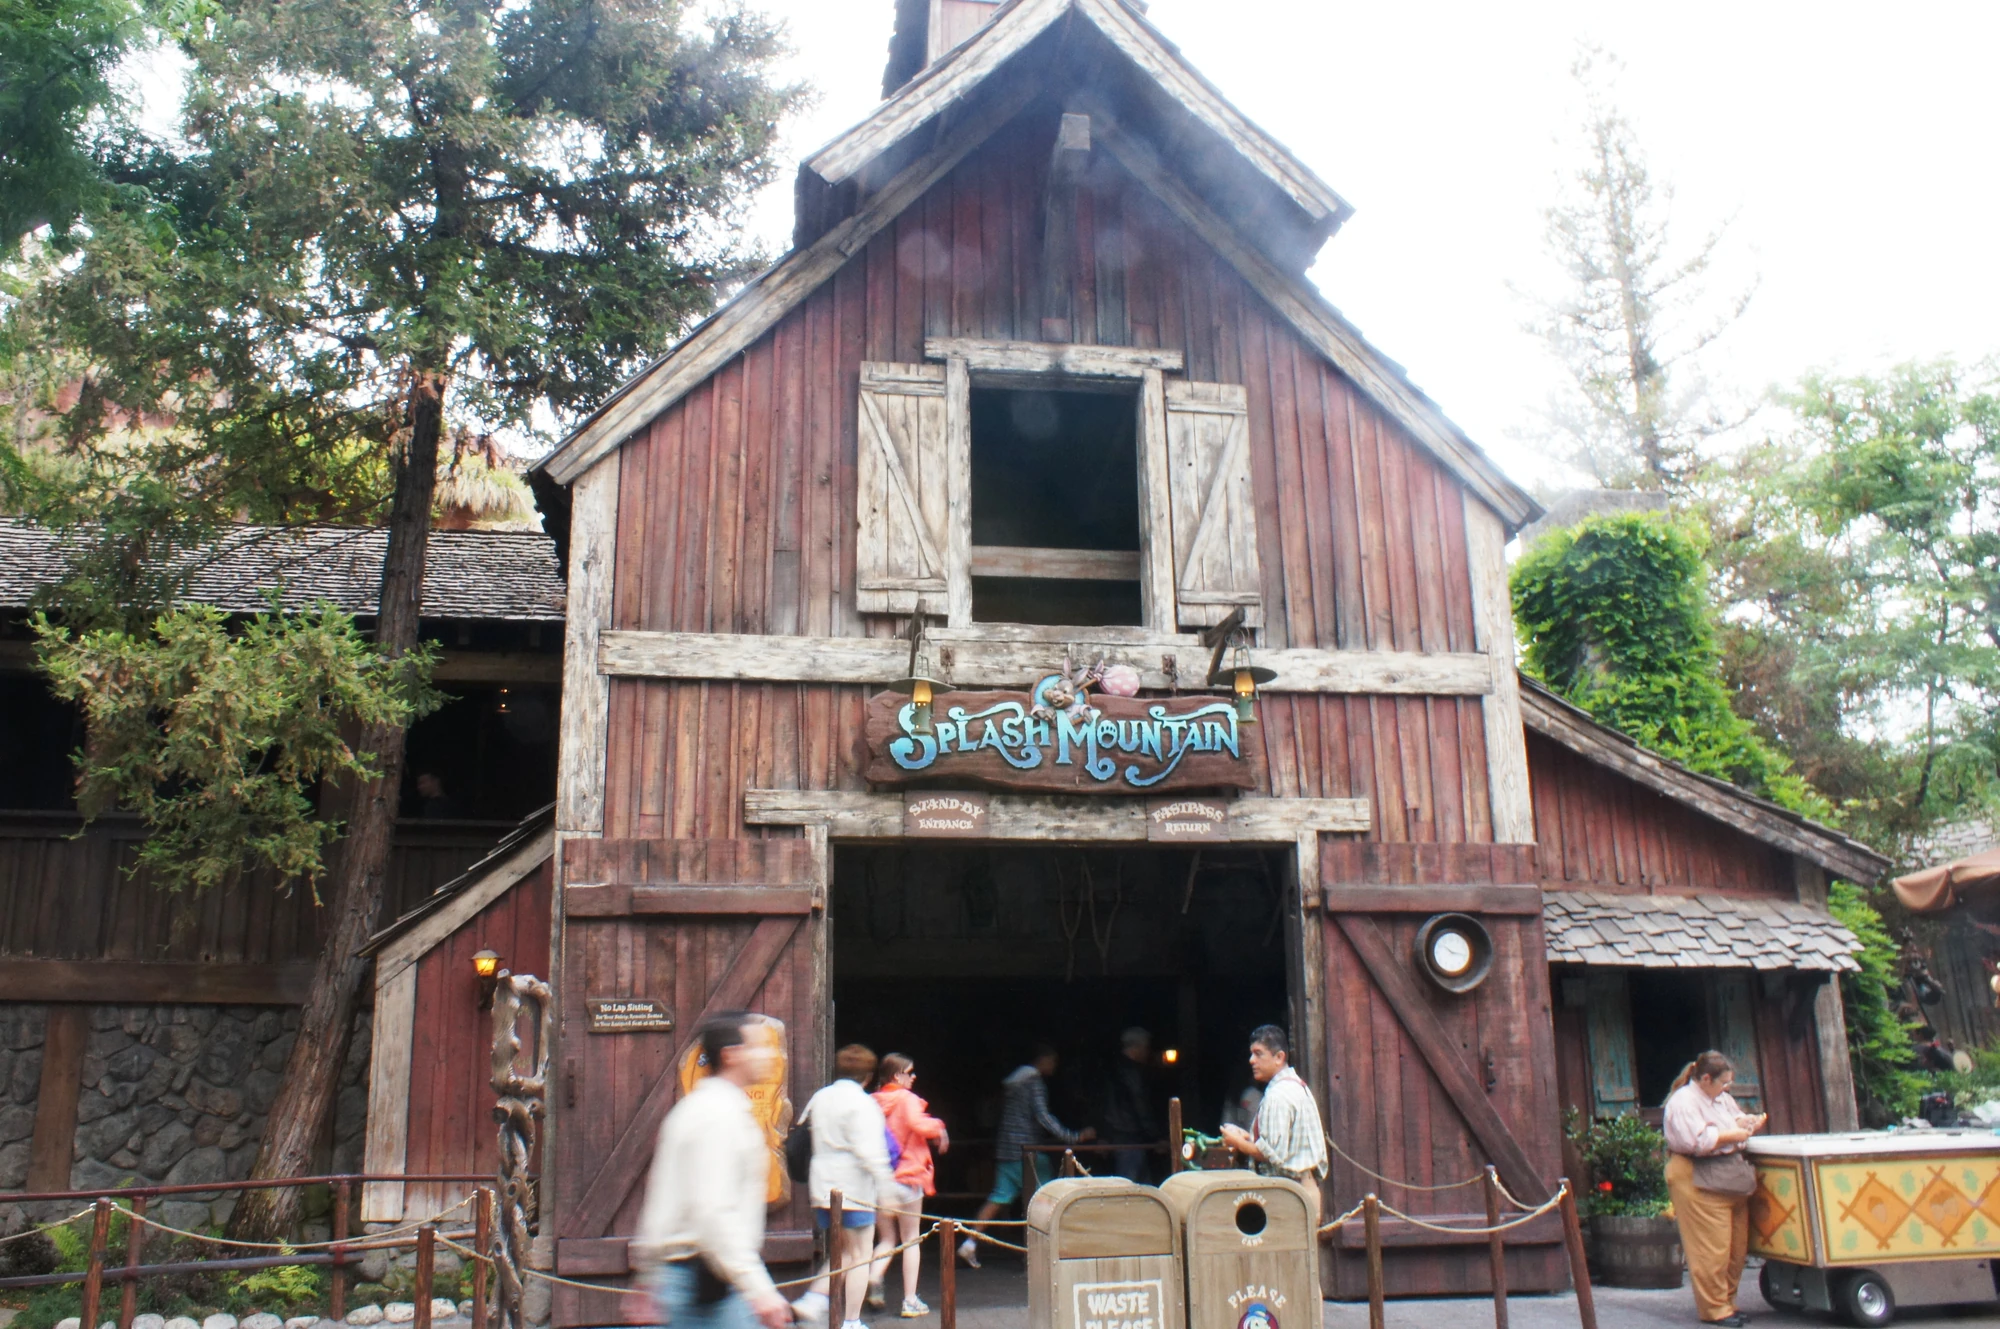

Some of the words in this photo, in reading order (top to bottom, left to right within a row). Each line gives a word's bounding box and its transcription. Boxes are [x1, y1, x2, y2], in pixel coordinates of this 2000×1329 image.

[889, 701, 1052, 770] SPLASH
[1055, 702, 1240, 787] MOUNTAIN
[909, 798, 985, 819] STAND-BY
[1152, 802, 1224, 824] FASTPASS
[919, 818, 974, 830] ENTRANCE
[1165, 822, 1211, 835] RETURN
[600, 1004, 612, 1013] No
[613, 1003, 627, 1013] Lap
[627, 1003, 653, 1012] Sitting
[1087, 1291, 1149, 1315] WASTE
[1228, 1284, 1287, 1308] PLEASE
